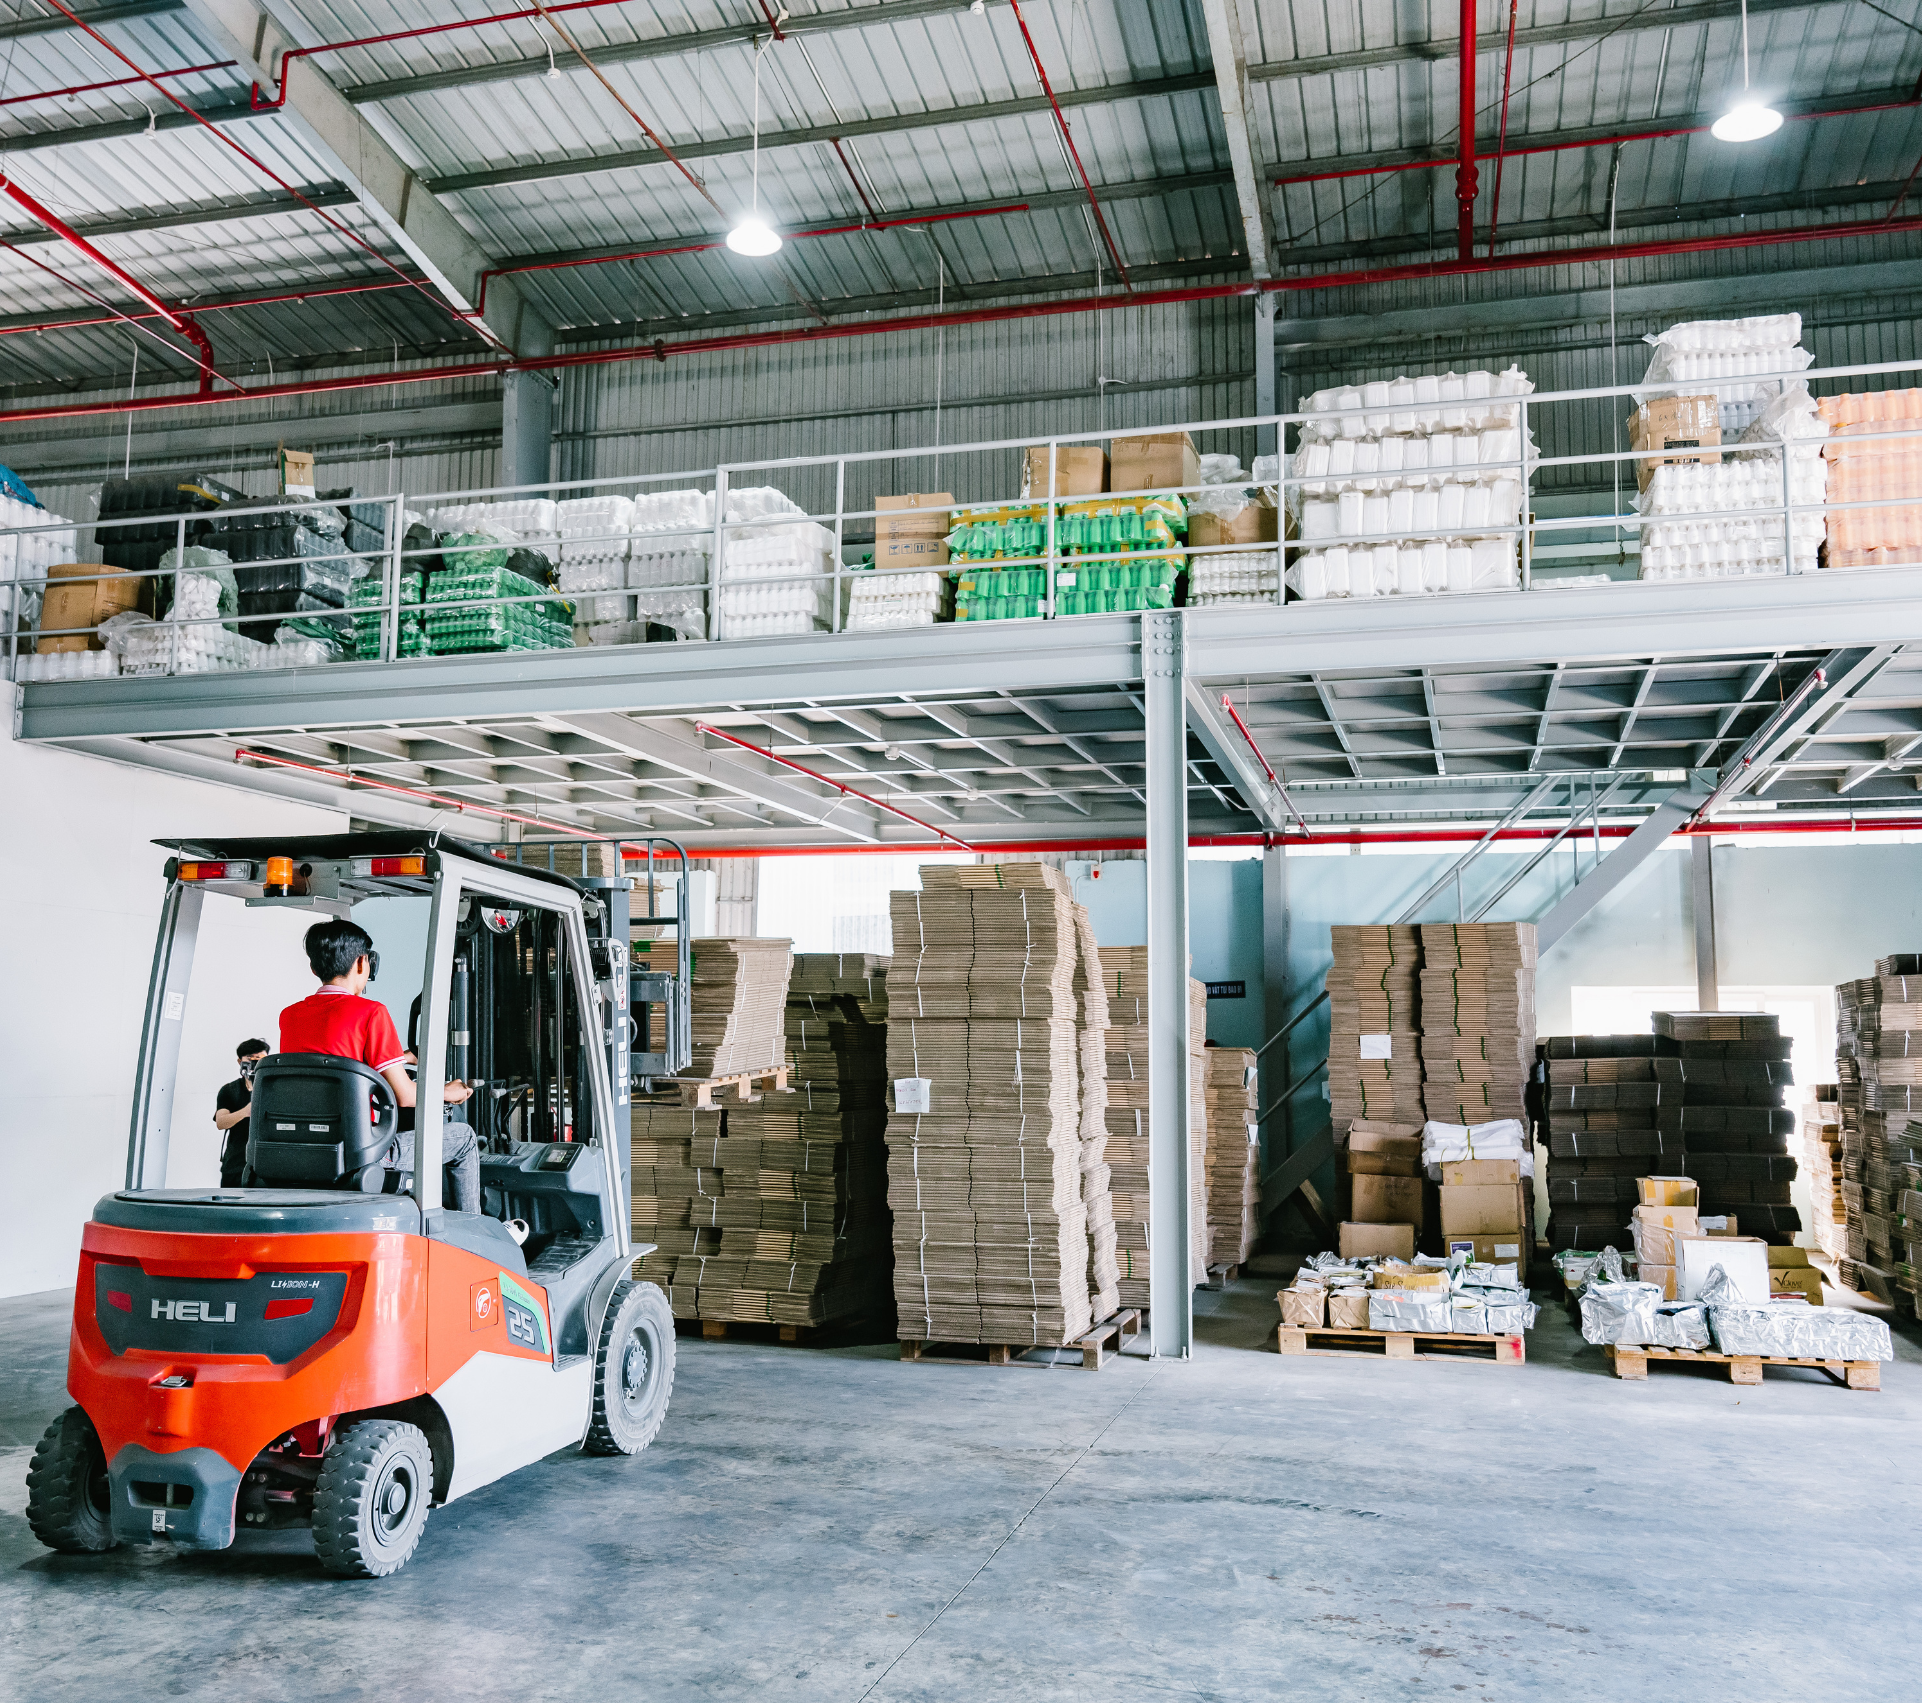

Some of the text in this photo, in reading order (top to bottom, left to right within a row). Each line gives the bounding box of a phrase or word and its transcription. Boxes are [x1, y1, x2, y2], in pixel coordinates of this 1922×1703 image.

[618, 1016, 628, 1106] HELI
[150, 1298, 237, 1323] HELI
[508, 1306, 535, 1345] 25
